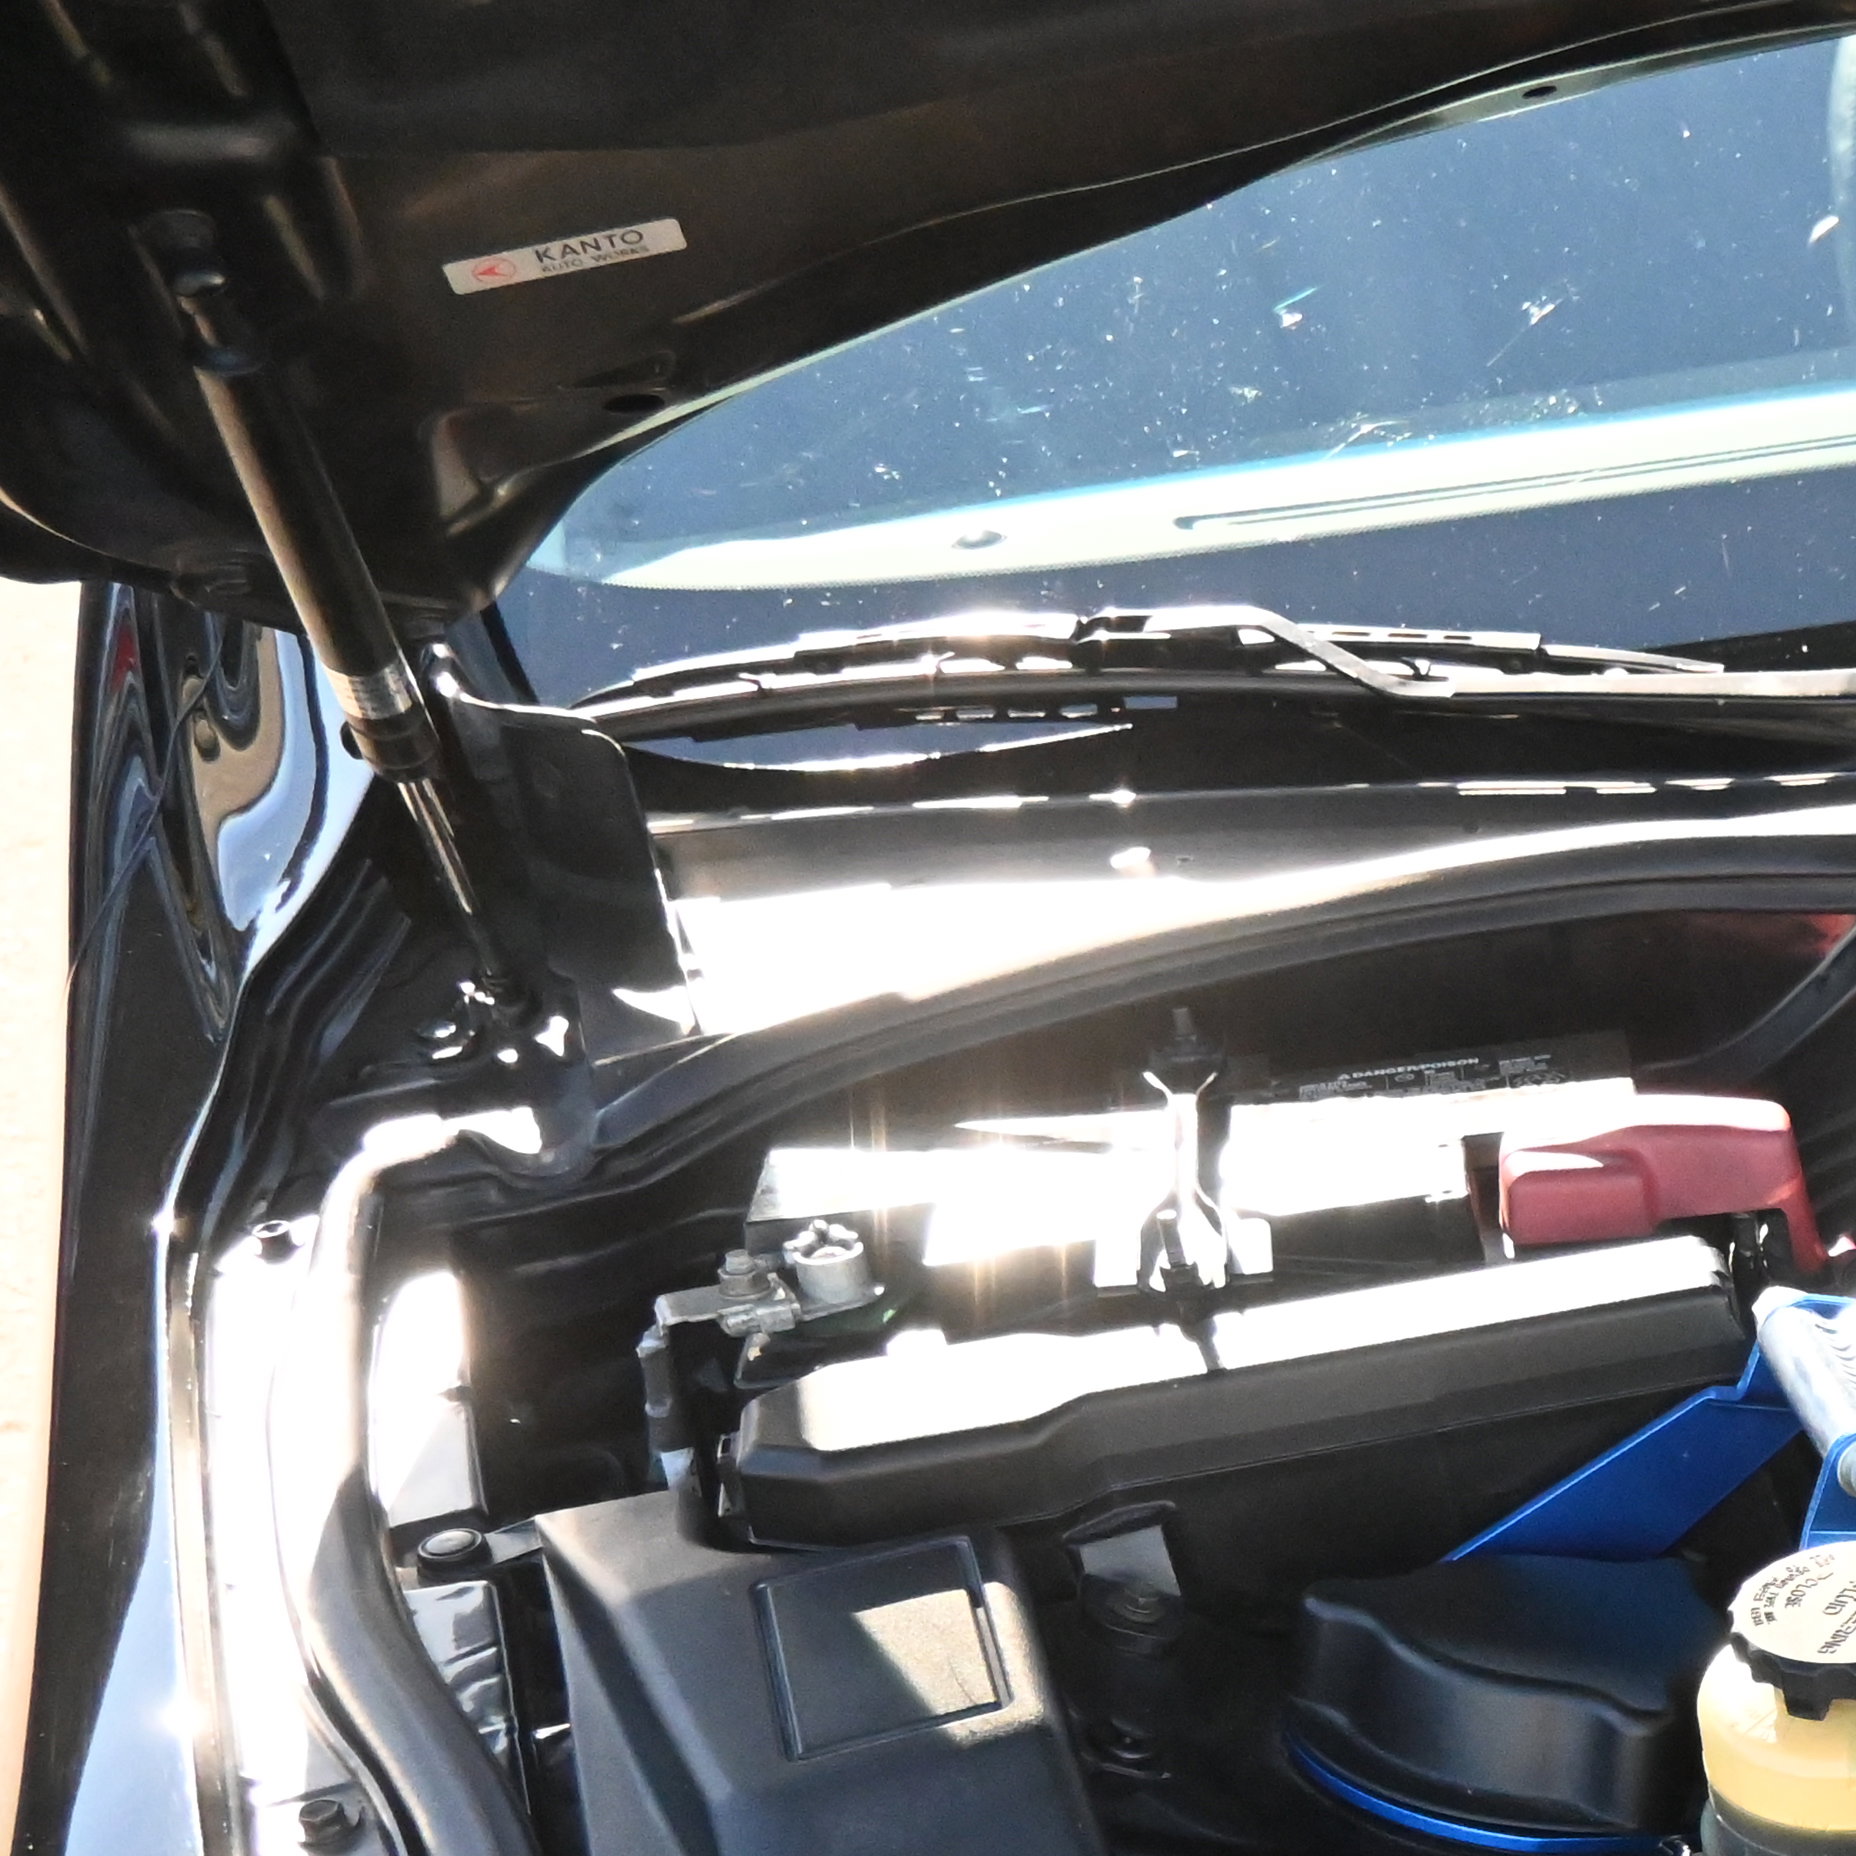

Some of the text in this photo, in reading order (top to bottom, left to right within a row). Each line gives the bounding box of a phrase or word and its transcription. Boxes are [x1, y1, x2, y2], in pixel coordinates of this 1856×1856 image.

[534, 229, 644, 263] KANTO
[541, 258, 584, 273] AUTO
[1784, 1578, 1819, 1608] CLOSE
